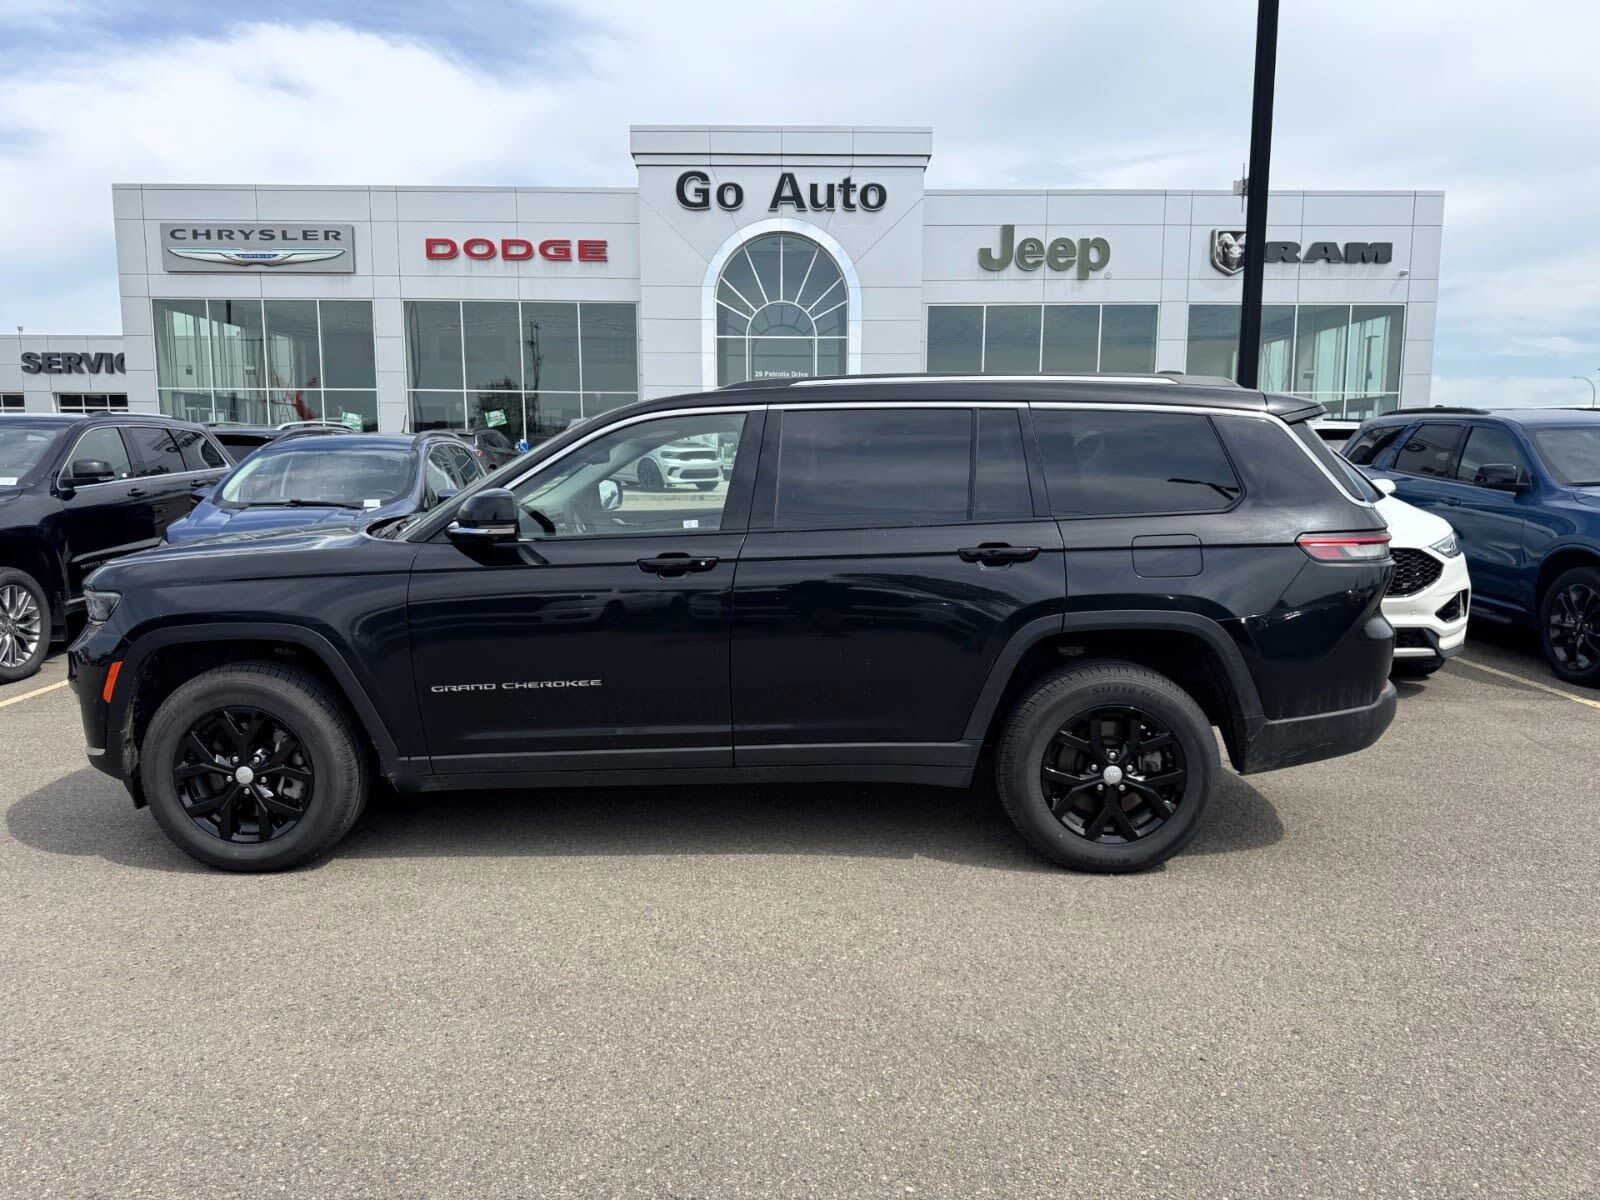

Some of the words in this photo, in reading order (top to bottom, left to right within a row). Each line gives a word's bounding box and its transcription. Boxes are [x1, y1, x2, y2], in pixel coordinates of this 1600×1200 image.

[676, 170, 744, 211] Go
[768, 172, 888, 212] Auto
[169, 228, 342, 241] CHRYSLER
[425, 238, 608, 261] DODGE
[978, 224, 1111, 280] Jeep
[1265, 241, 1393, 264] RAM
[431, 683, 496, 693] GRAND
[502, 679, 602, 690] CHEROKEE
